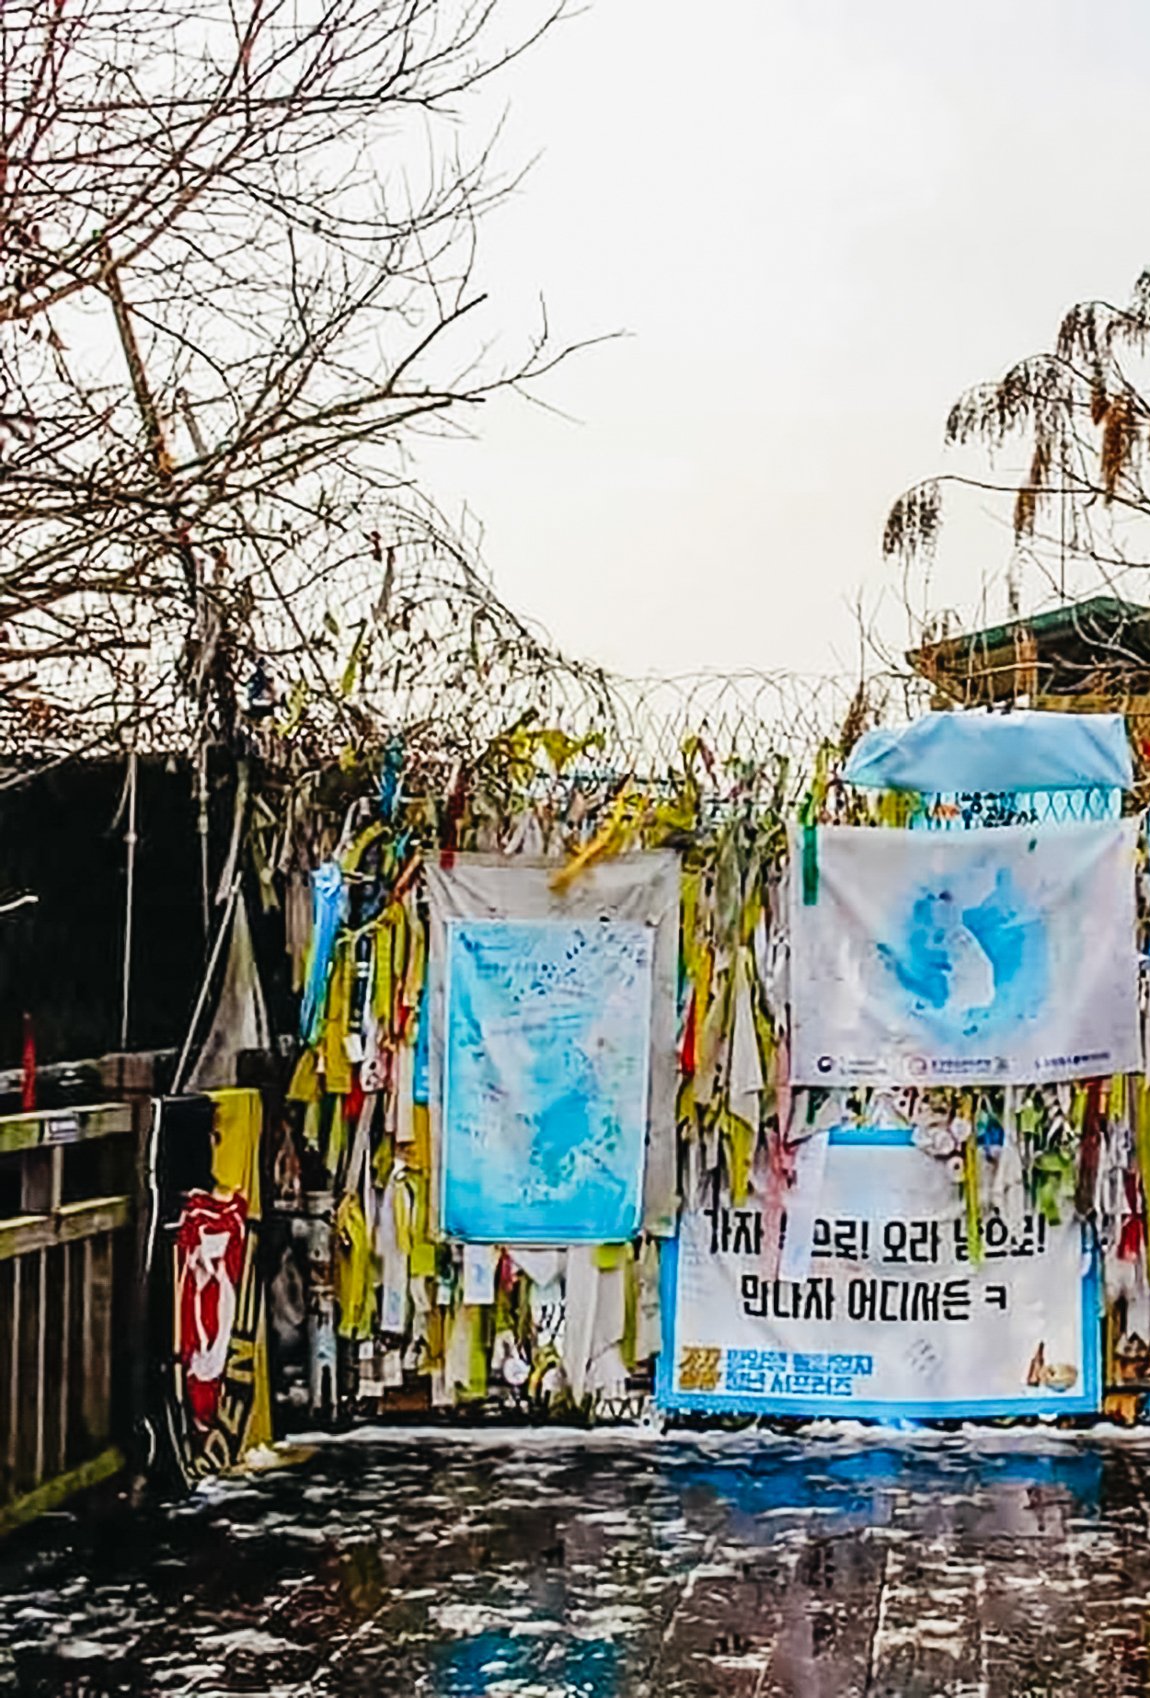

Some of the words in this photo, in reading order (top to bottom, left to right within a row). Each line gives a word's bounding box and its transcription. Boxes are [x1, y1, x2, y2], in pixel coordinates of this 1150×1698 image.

[703, 1208, 765, 1255] 가자
[777, 1209, 869, 1261] 으로!
[882, 1220, 939, 1263] 오라
[741, 1274, 835, 1320] 만나자
[848, 1278, 971, 1322] 어디서든
